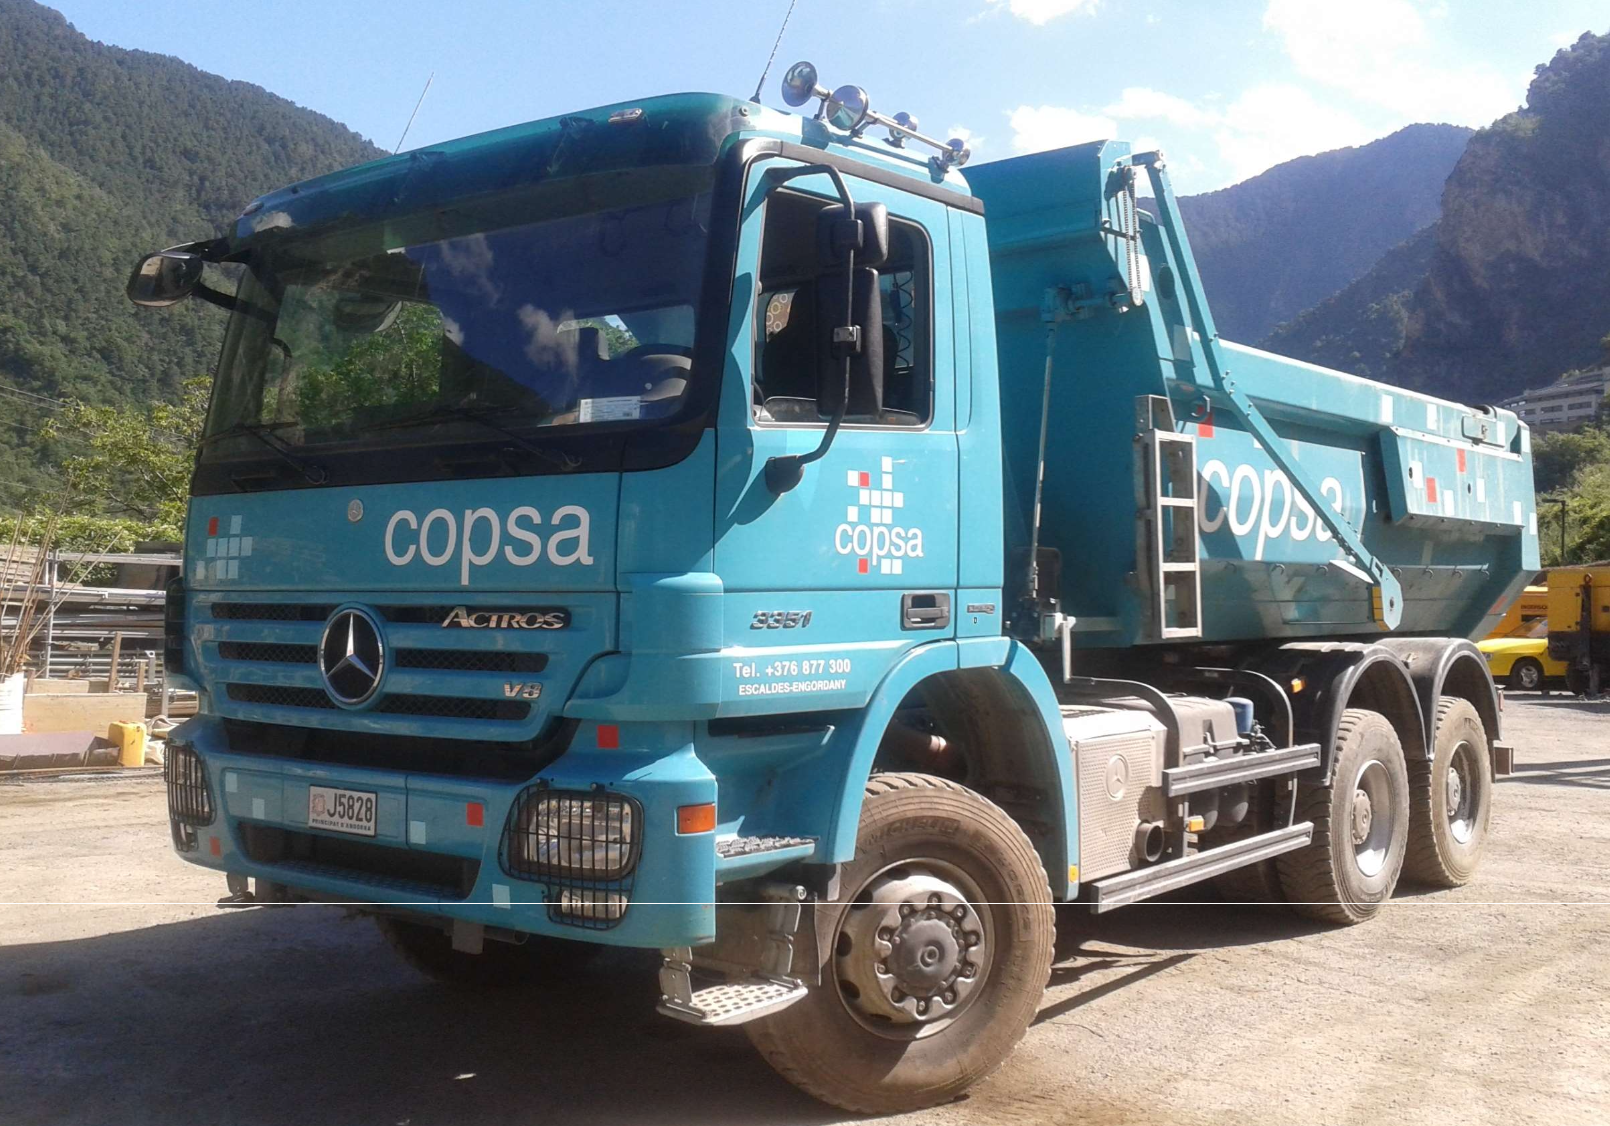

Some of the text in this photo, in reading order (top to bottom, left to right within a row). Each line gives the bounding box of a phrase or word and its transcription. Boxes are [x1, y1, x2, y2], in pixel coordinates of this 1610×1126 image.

[384, 504, 594, 586] copsa
[834, 522, 924, 566] copsa
[750, 610, 813, 630] 3351
[733, 658, 851, 678] Tel. +376 877 300
[503, 681, 542, 699] V8
[738, 679, 847, 696] ESCALDES-ENGORDANY
[326, 792, 373, 823] J5828
